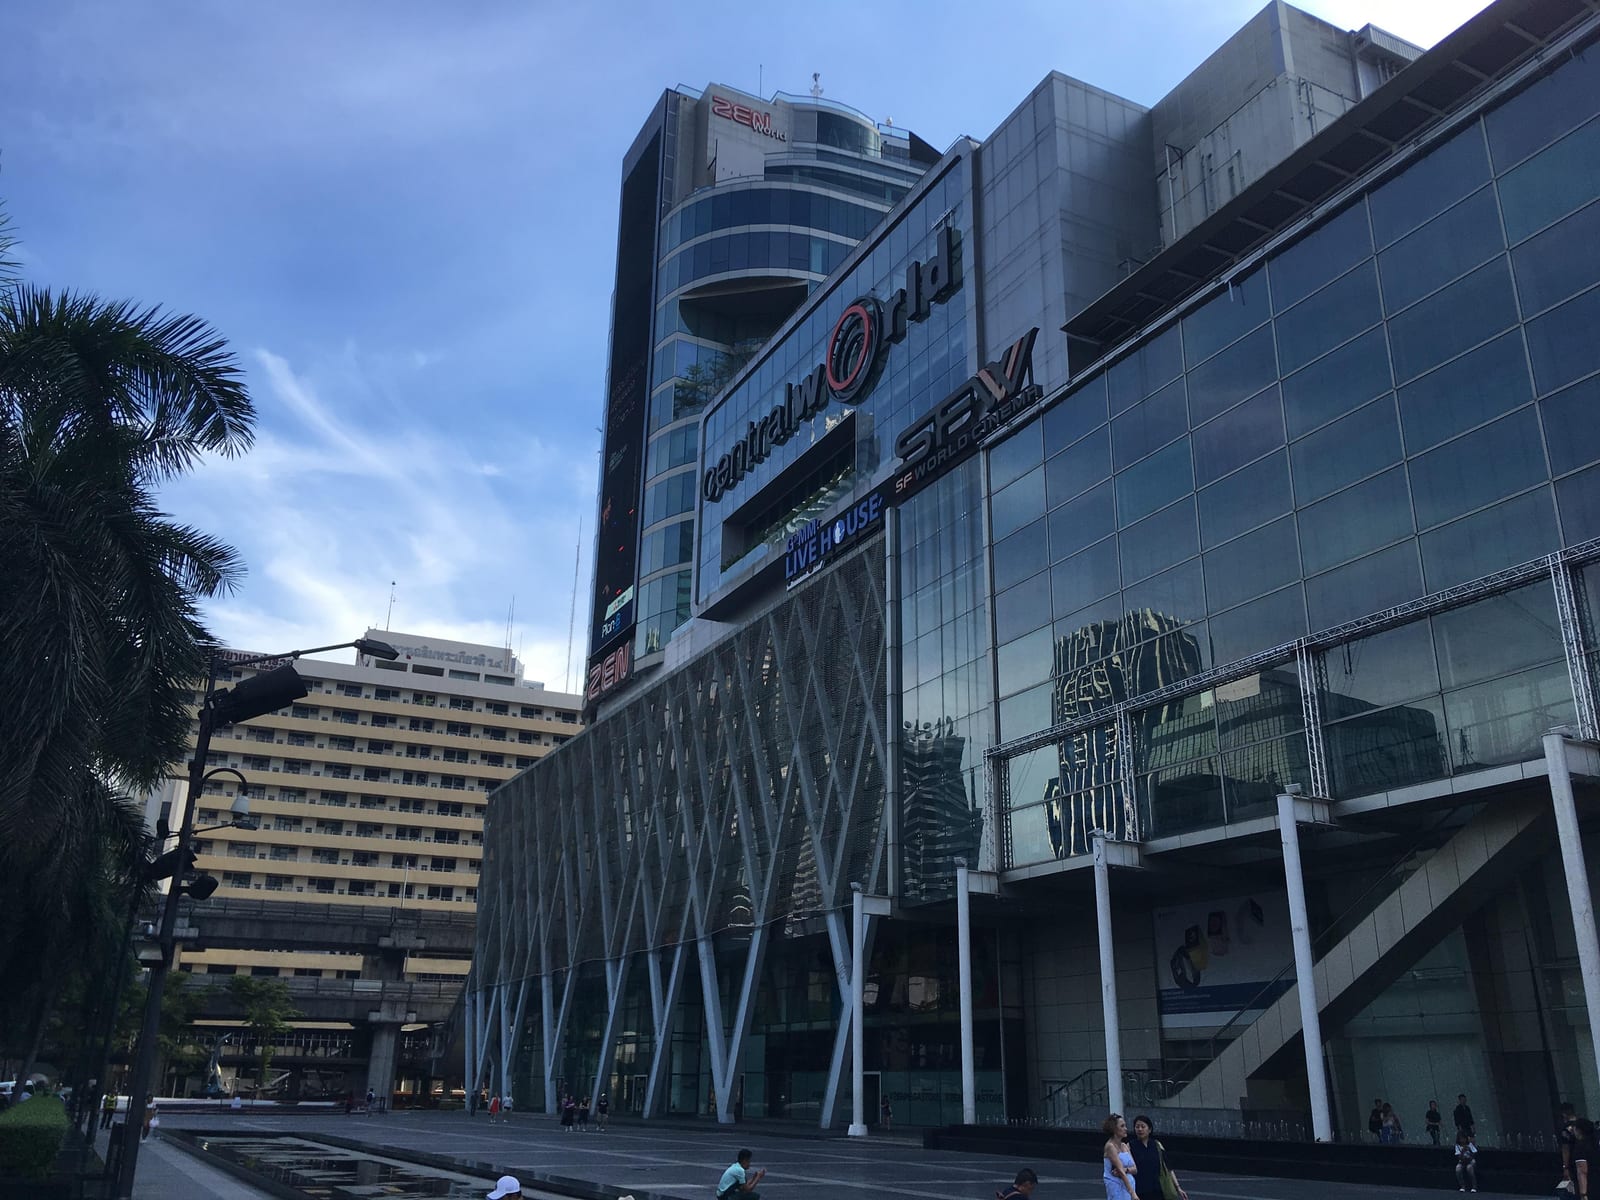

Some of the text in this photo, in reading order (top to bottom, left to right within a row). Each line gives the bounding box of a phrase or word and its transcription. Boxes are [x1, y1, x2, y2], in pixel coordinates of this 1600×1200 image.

[711, 95, 771, 129] ZEN
[752, 121, 787, 142] World
[895, 385, 1041, 494] SF WORLD CINEMA
[785, 537, 817, 579] LIVE
[820, 493, 880, 555] HOUSE
[588, 640, 630, 700] ZEN
